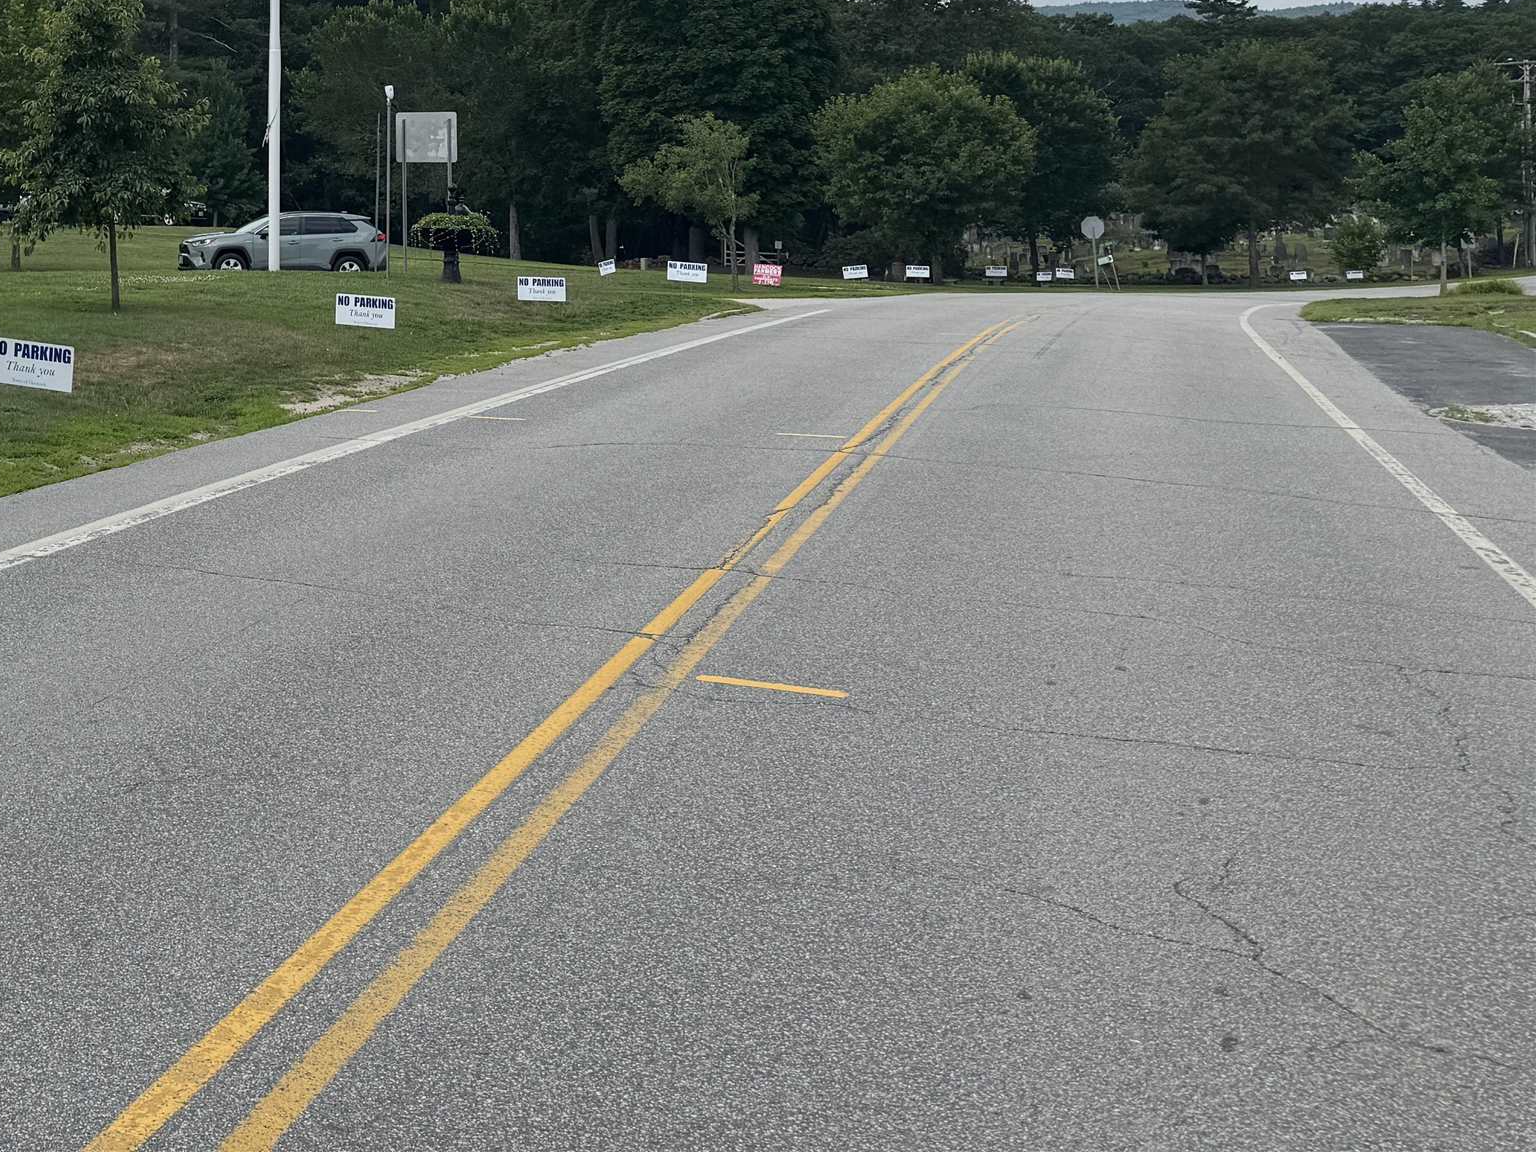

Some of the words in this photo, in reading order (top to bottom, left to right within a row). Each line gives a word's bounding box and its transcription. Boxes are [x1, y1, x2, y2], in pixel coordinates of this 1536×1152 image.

[679, 263, 706, 272] PARKING
[519, 278, 529, 286] NO
[532, 278, 564, 287] PARKING
[337, 295, 350, 306] NO
[354, 297, 393, 310] PARKING
[14, 342, 71, 364] PARKING
[6, 360, 37, 374] Thank
[37, 368, 55, 378] you
